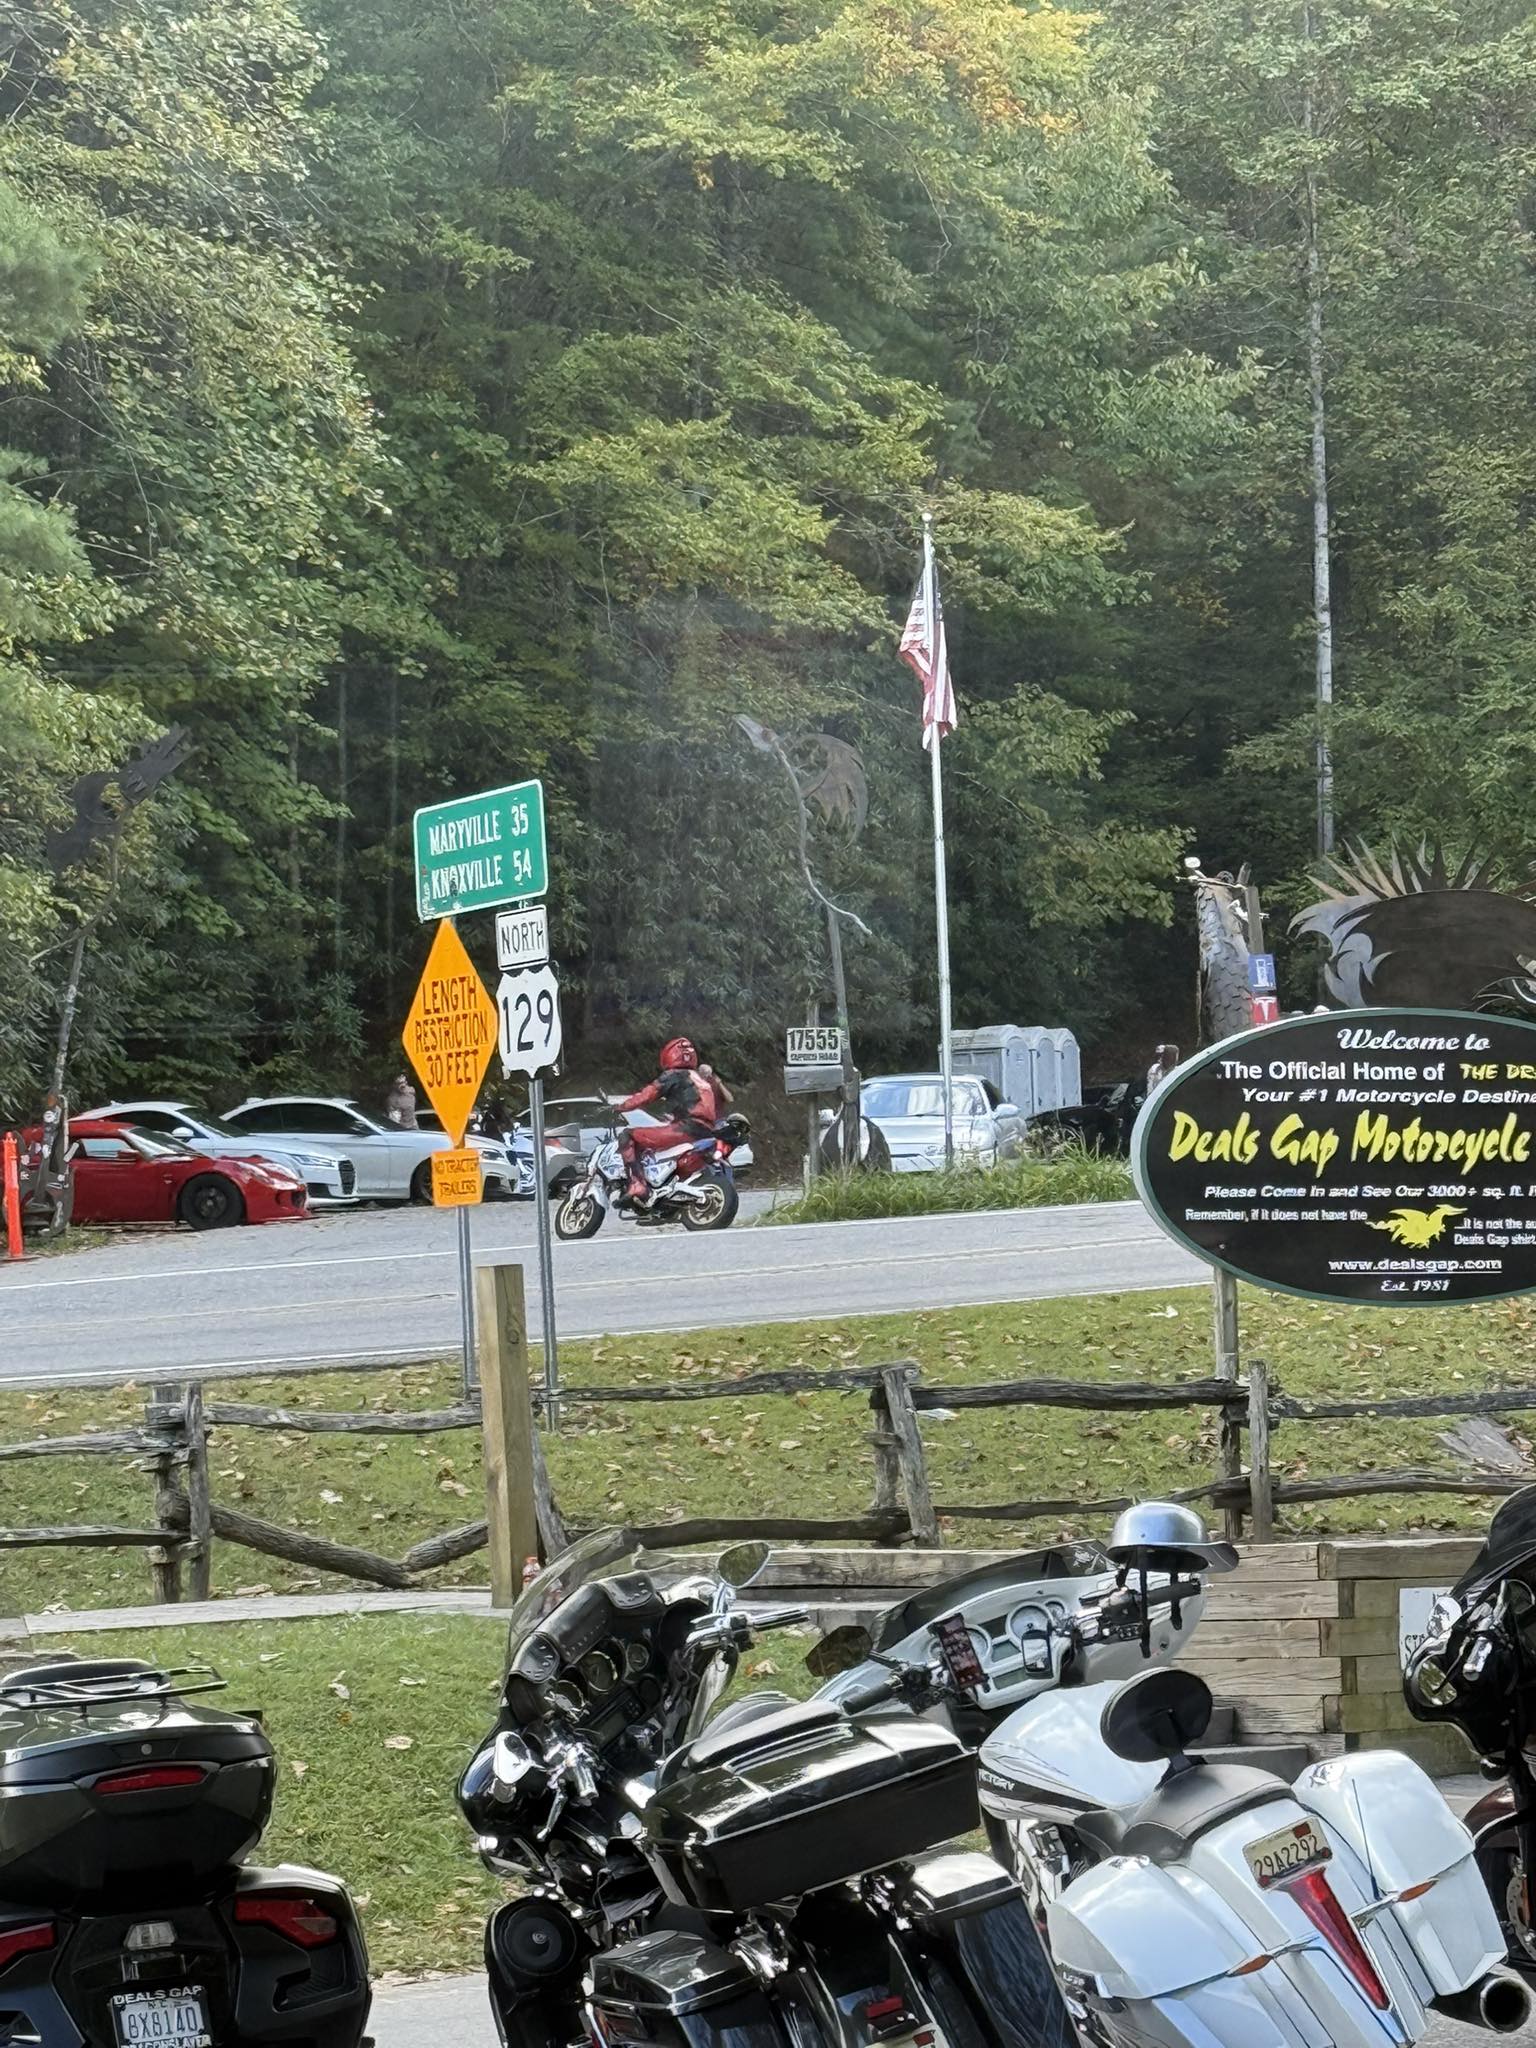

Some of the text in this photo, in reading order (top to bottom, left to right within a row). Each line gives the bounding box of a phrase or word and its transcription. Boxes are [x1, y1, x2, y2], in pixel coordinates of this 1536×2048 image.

[429, 803, 529, 856] MARYVILLE 35
[431, 855, 503, 899] KNOXVILLE
[513, 848, 532, 881] 54
[501, 919, 544, 954] NORTH
[422, 976, 477, 1015] LENGTH
[415, 1010, 488, 1054] RESTRICTION
[503, 989, 553, 1054] 129
[787, 1029, 838, 1050] 17555
[1337, 1028, 1491, 1050] Welcome to
[426, 1049, 479, 1088] 30 FEET
[1220, 1061, 1262, 1079] The
[1269, 1061, 1345, 1079] Official
[1353, 1062, 1418, 1080] Home
[1423, 1062, 1445, 1081] of
[1459, 1063, 1499, 1081] THE
[1242, 1088, 1294, 1102] Your
[1299, 1088, 1329, 1102] #1
[1335, 1088, 1456, 1106] Motorcycle
[1168, 1109, 1532, 1178] Deals Gap Motorcycle
[1204, 1186, 1257, 1198] Please
[1261, 1186, 1306, 1197] Come
[1328, 1186, 1358, 1197] and
[1361, 1186, 1392, 1197] See
[1395, 1185, 1424, 1197] Our
[1427, 1185, 1477, 1197] 3000+
[1185, 1209, 1249, 1222] Remember,
[1271, 1209, 1299, 1220] does
[1301, 1210, 1319, 1220] not
[1321, 1209, 1347, 1220] have
[1349, 1209, 1367, 1220] the
[1473, 1218, 1484, 1229] is
[1485, 1218, 1503, 1229] not
[1505, 1218, 1522, 1229] the
[1328, 1258, 1502, 1272] www.dealsgap.com
[1412, 1279, 1450, 1291] 1981
[113, 1985, 203, 2005] DEALS GAP
